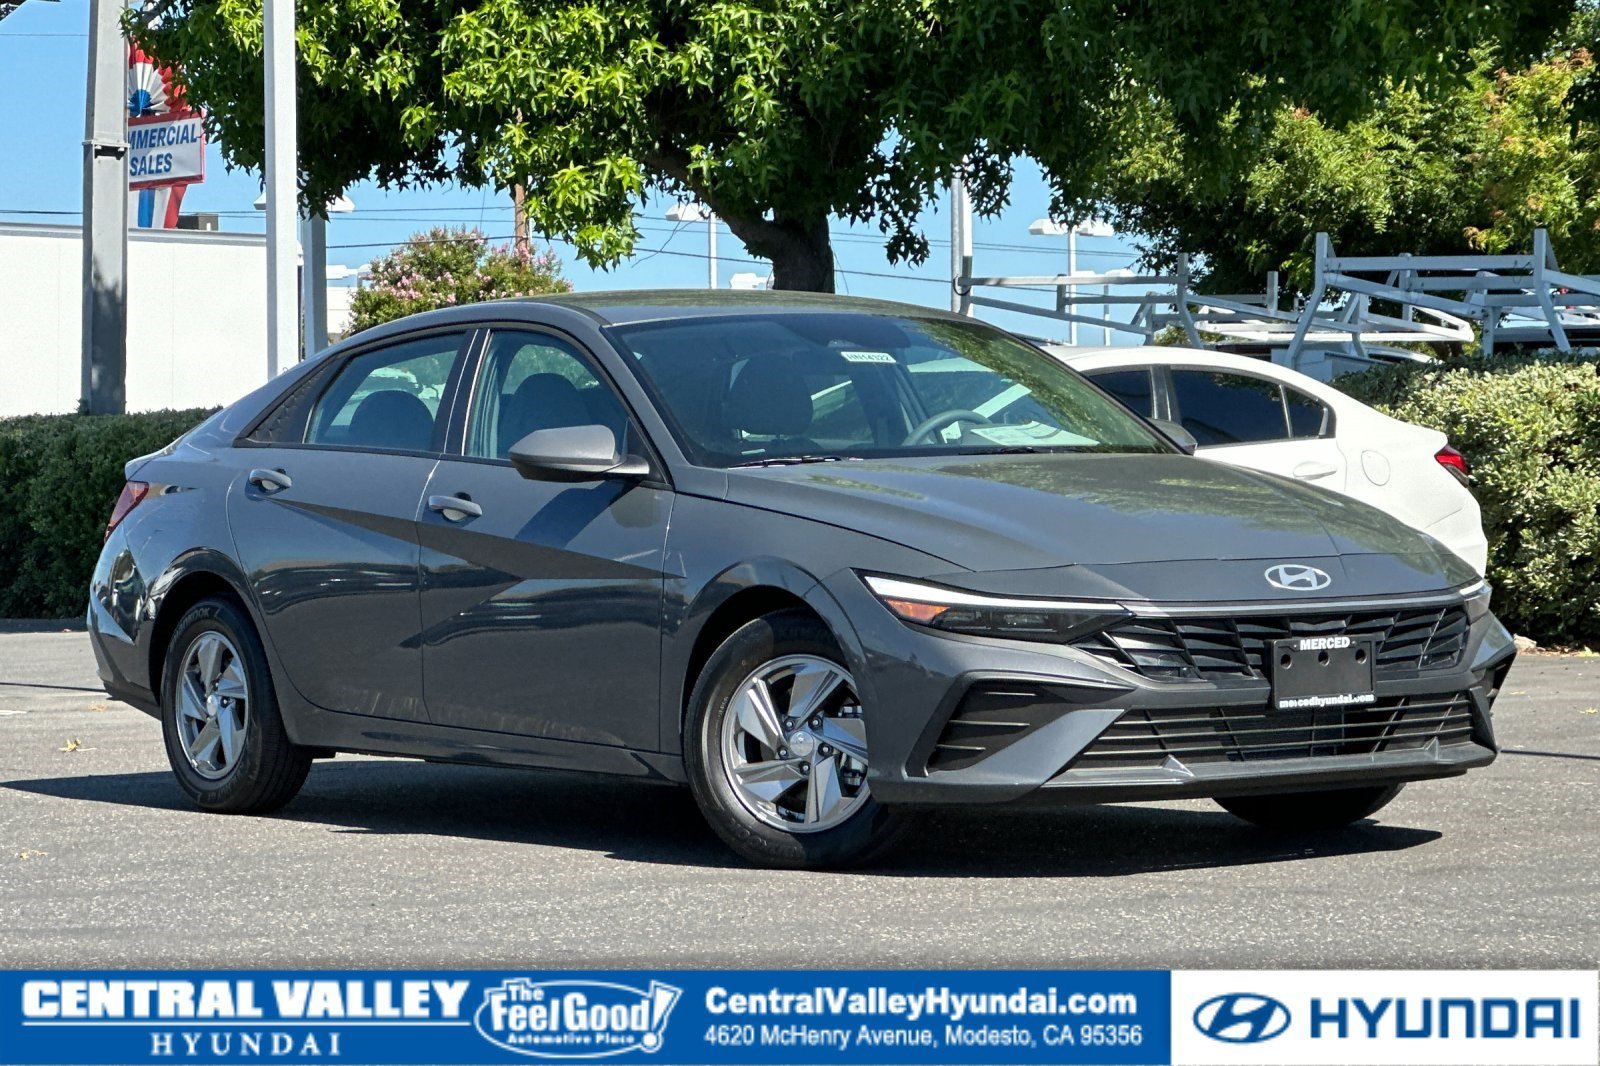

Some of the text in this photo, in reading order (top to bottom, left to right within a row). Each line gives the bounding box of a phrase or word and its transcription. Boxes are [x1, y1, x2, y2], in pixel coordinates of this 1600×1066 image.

[128, 123, 197, 150] MMERCIAL
[129, 152, 172, 177] SALES
[1299, 636, 1351, 651] MERCED
[1279, 693, 1375, 709] mercedhyundai.com
